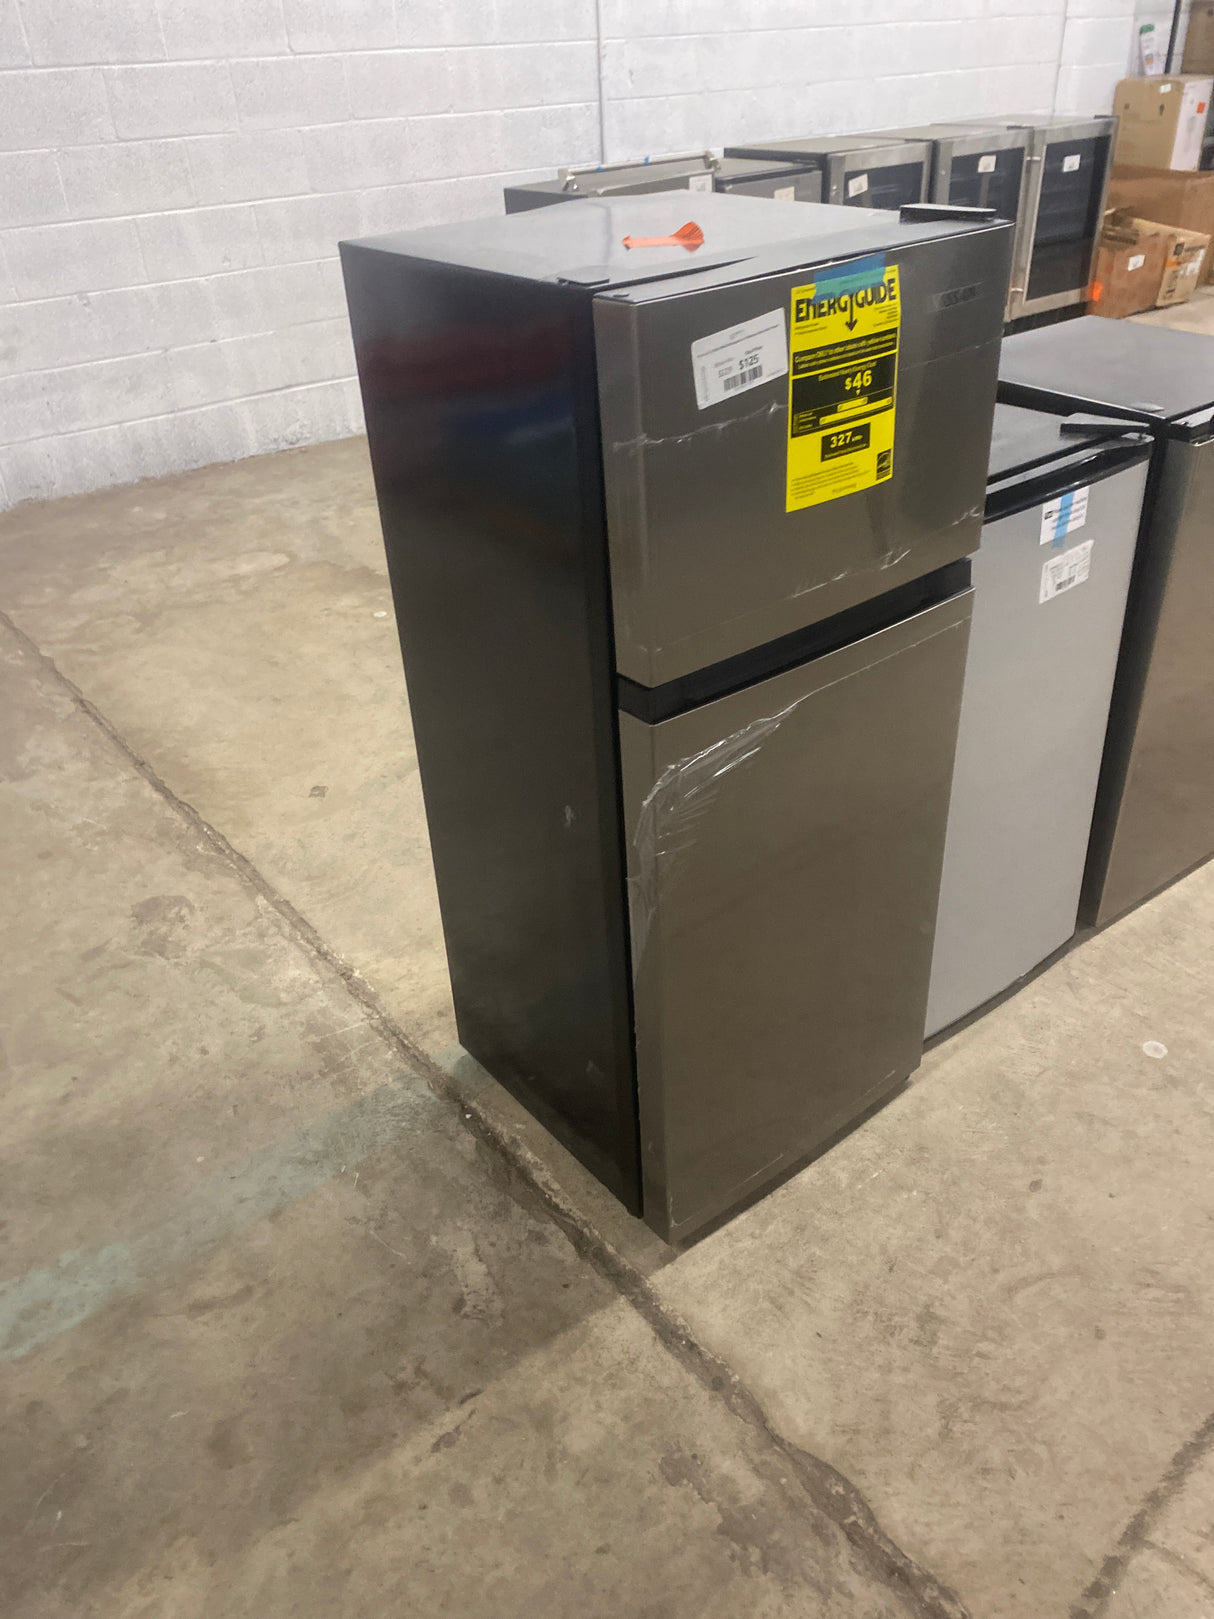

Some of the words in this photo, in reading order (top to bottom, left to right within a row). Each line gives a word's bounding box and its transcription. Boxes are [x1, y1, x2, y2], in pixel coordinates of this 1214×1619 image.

[738, 353, 760, 370] $125
[845, 369, 873, 391] $46
[830, 431, 853, 448] 327
